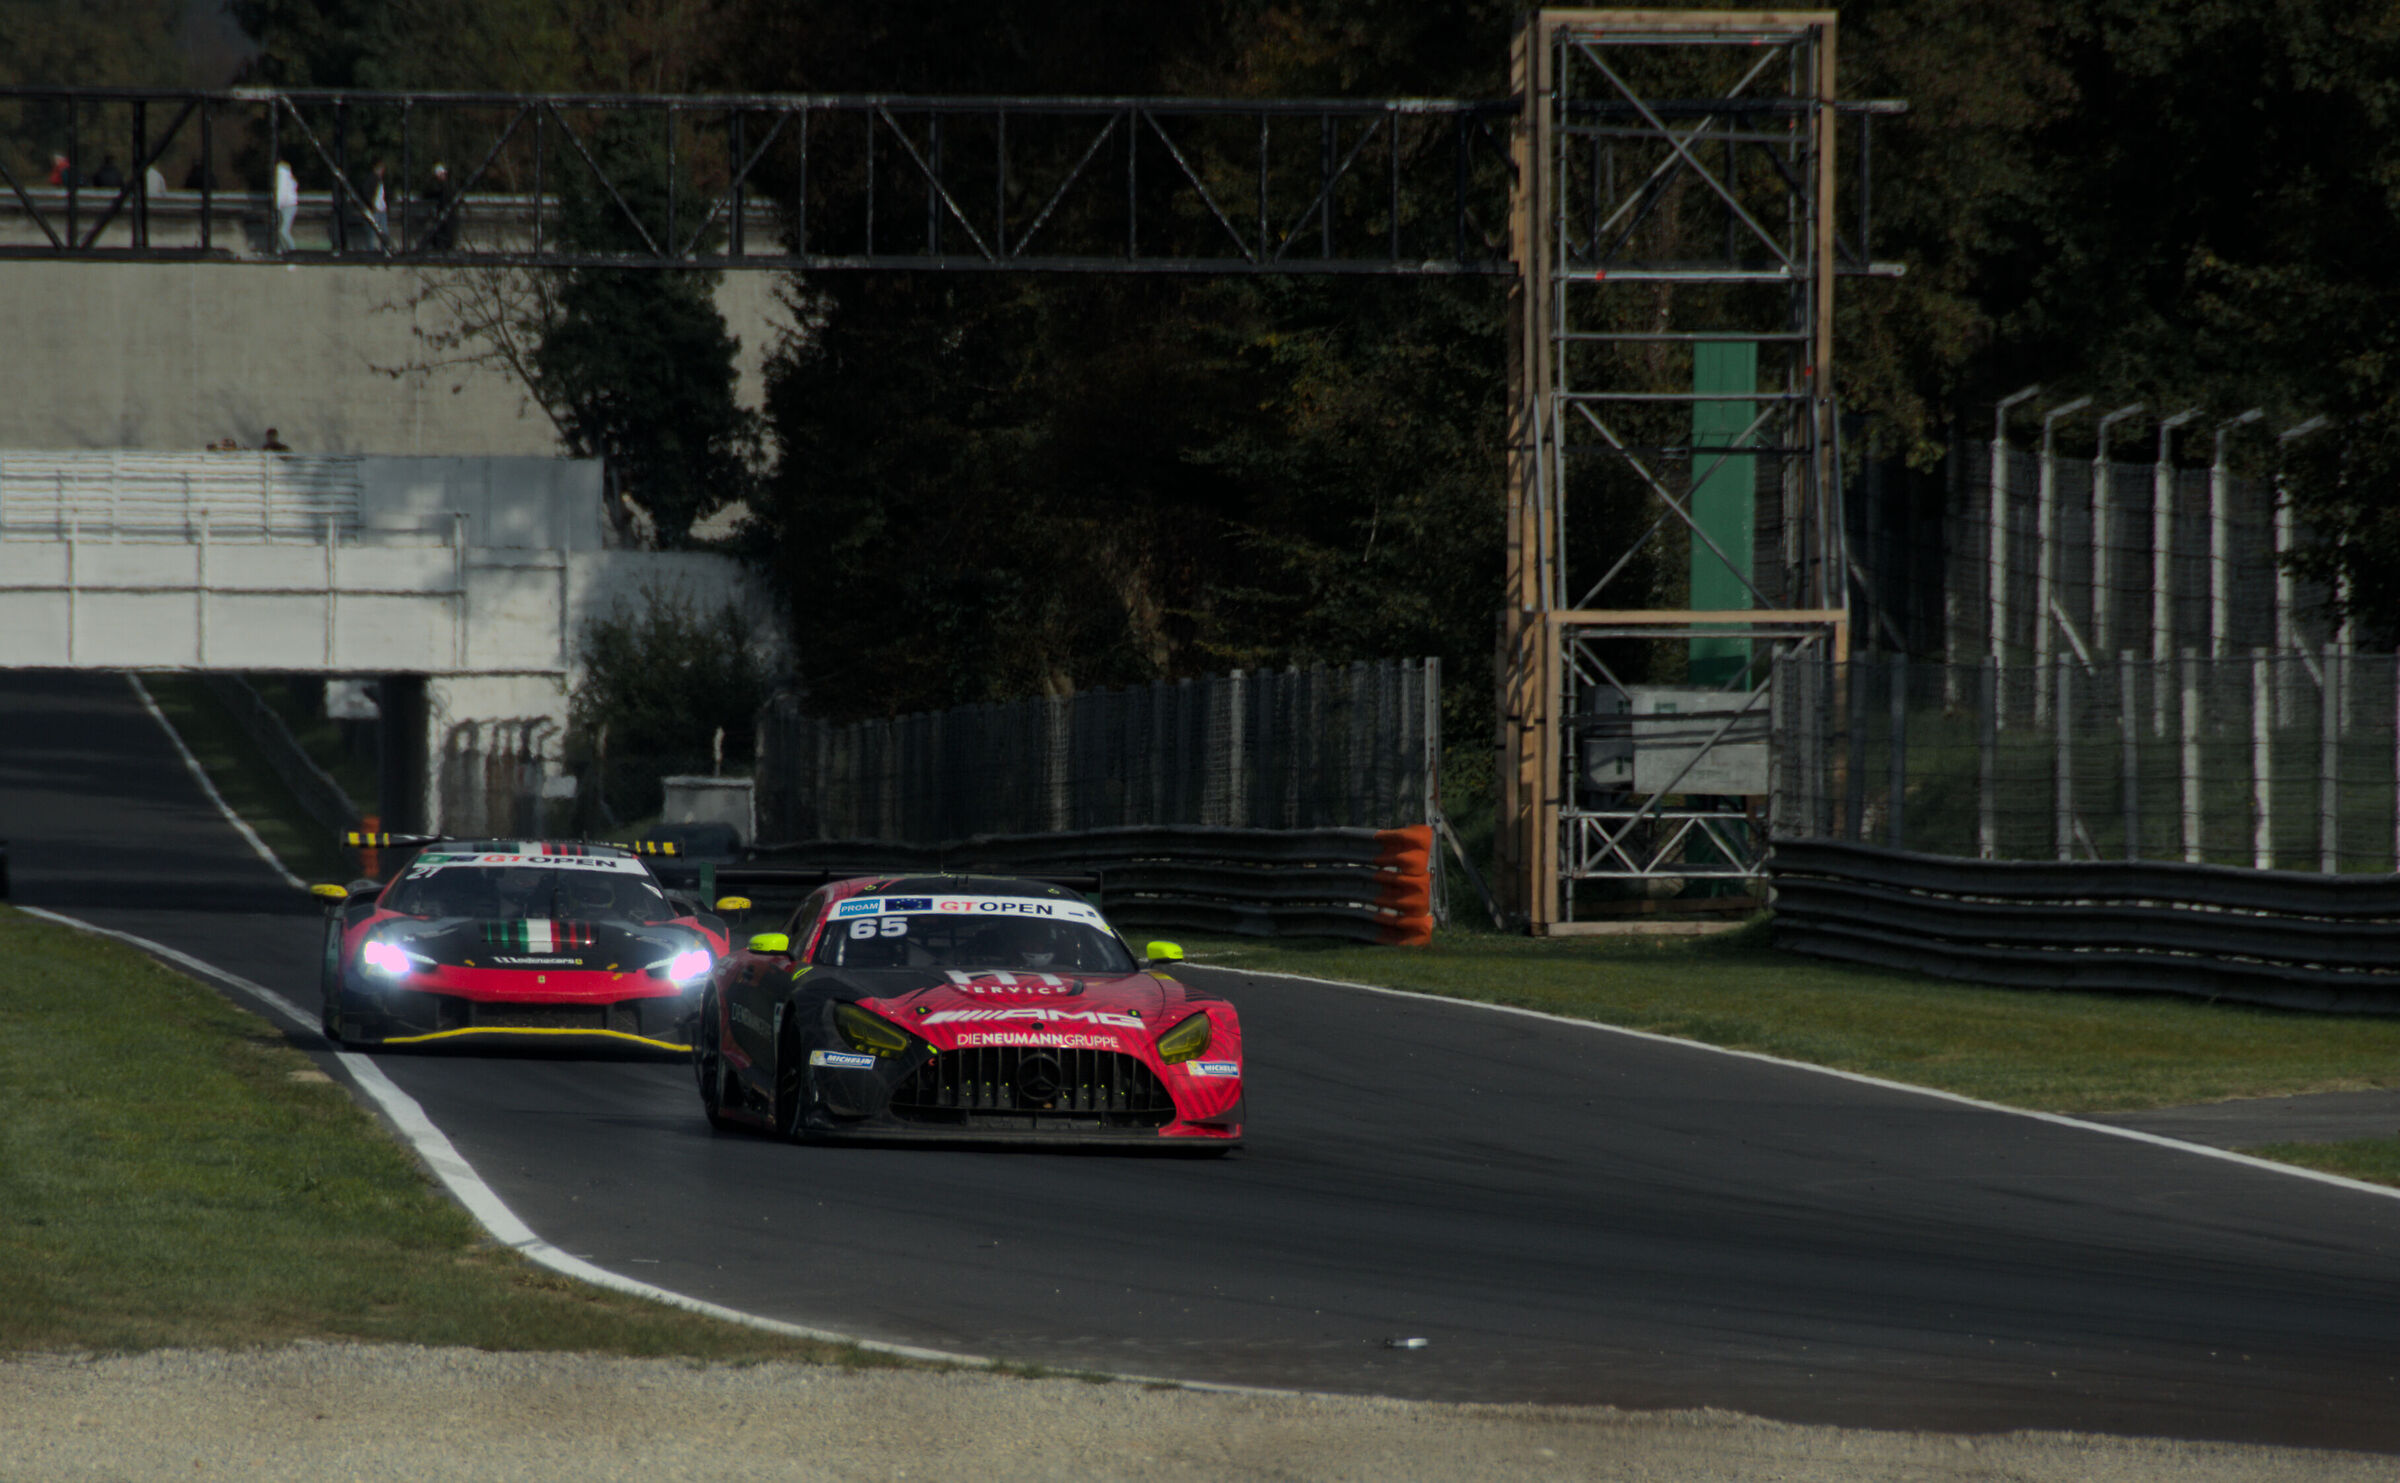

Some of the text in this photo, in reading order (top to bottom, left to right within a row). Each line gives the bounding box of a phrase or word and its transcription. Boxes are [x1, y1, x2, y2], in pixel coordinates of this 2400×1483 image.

[840, 902, 879, 914] PROAM
[850, 917, 908, 939] 65
[827, 1054, 873, 1065] MICHELIN
